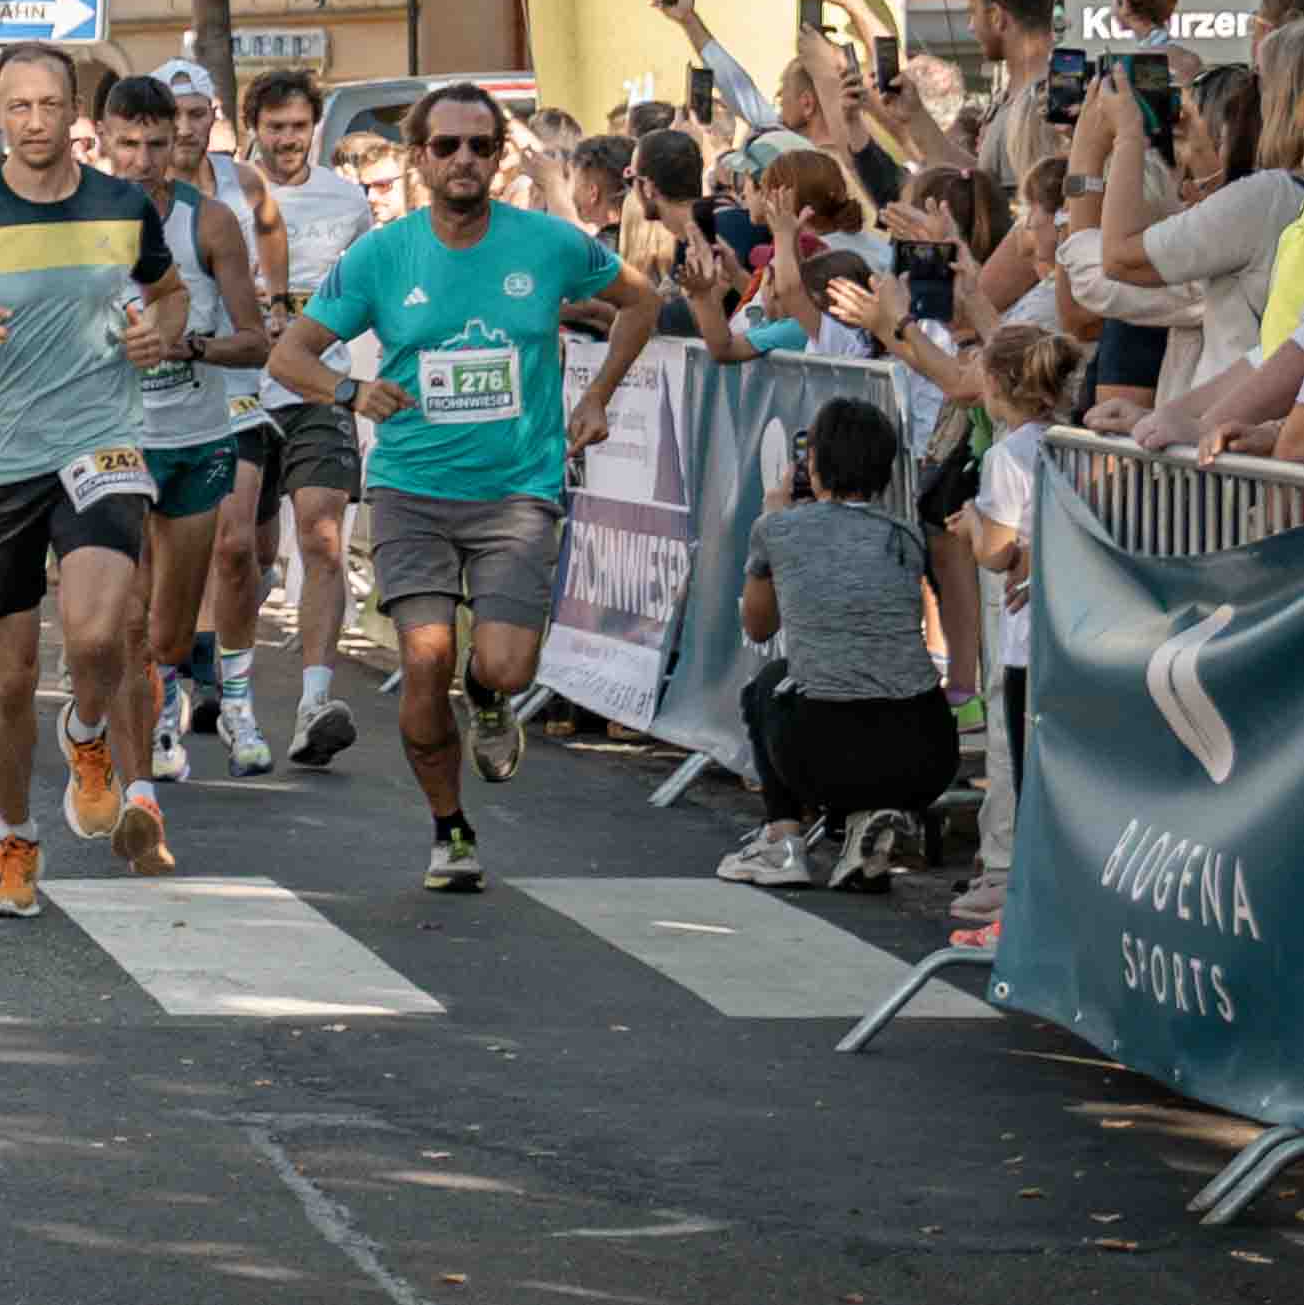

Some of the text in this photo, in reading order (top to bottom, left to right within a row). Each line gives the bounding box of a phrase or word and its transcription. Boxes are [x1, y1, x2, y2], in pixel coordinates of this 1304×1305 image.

[461, 370, 504, 392] 276
[1101, 818, 1261, 941] BIOGENA
[1121, 932, 1234, 1023] SPORTS
